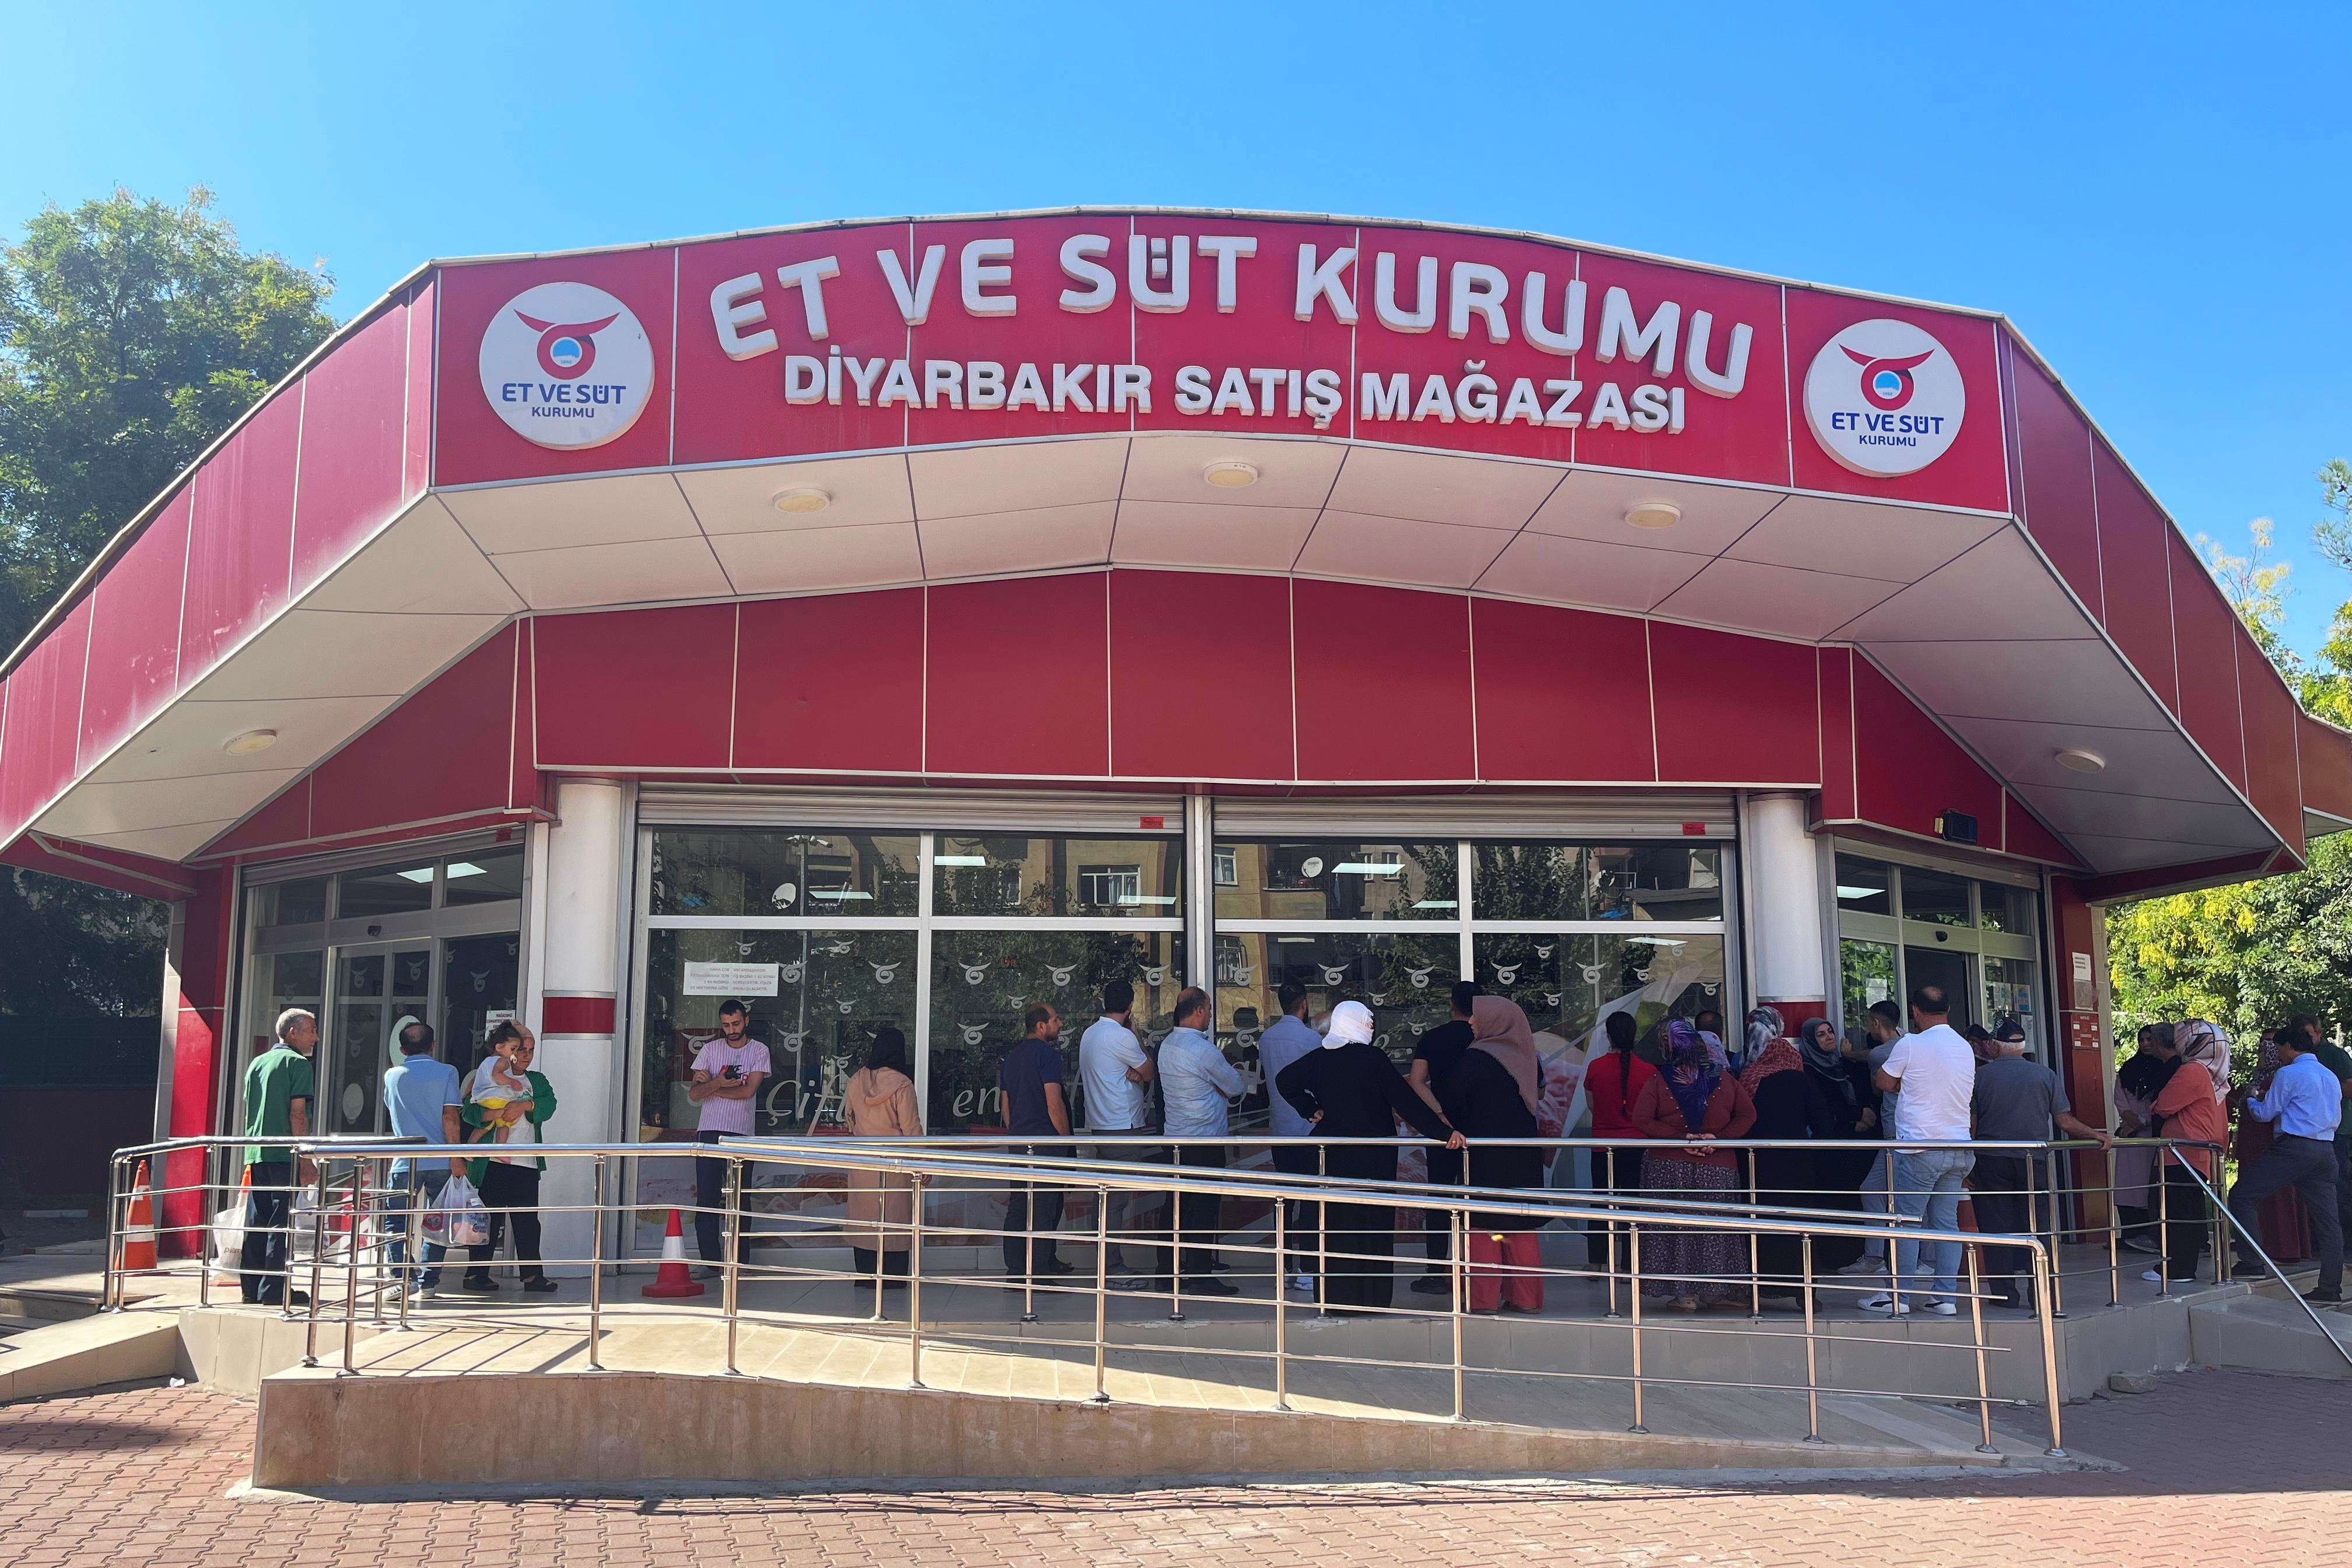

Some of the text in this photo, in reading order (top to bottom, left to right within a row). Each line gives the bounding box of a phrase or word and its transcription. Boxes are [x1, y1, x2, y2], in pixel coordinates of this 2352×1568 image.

[710, 233, 1754, 399] ET VE SÜT KURUMU
[502, 383, 626, 404] ET VE SÜT
[785, 345, 1685, 435] DİYARBAKIR SATIŞ MAĞAZASI
[531, 407, 594, 418] KURUMU
[1832, 412, 1944, 435] ET VE SÜT
[1859, 435, 1917, 447] KURUMU
